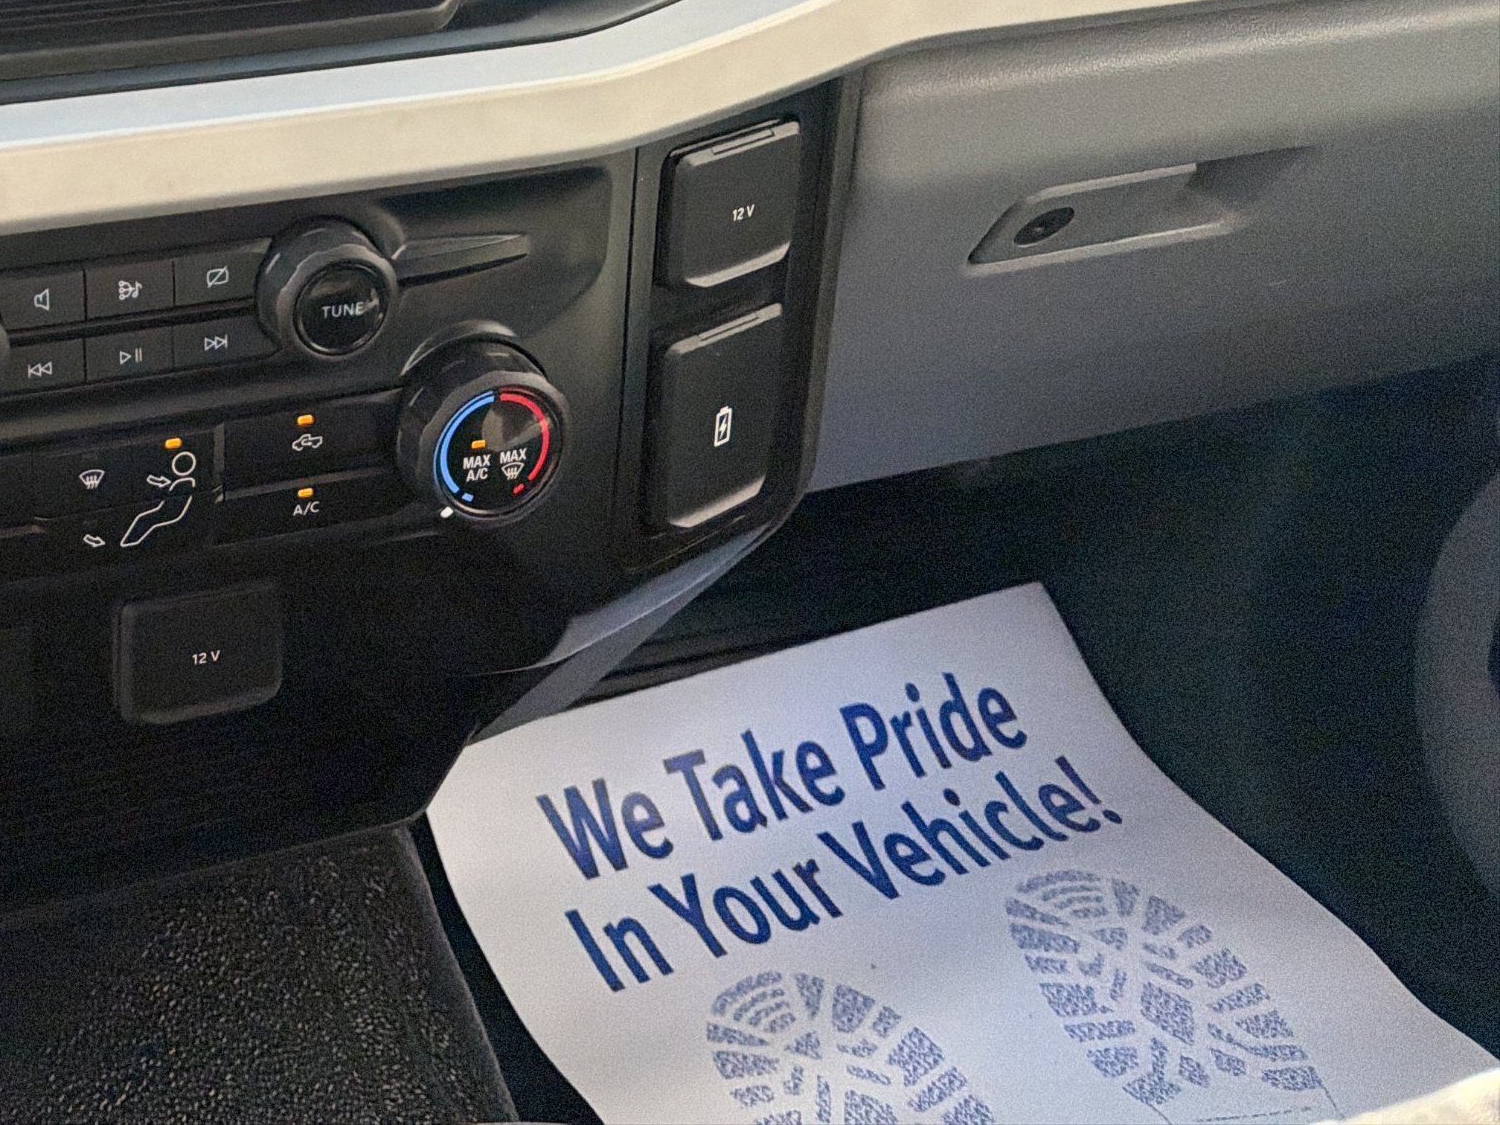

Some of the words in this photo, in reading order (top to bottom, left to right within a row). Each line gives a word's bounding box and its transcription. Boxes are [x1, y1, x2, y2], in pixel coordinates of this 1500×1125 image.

[733, 208, 746, 221] 12
[747, 203, 756, 218] V
[321, 301, 365, 319] TUNE
[463, 454, 491, 469] MAX
[500, 448, 528, 463] MAX
[466, 469, 488, 483] A/C
[293, 500, 320, 517] A/C
[192, 653, 207, 665] 12
[209, 650, 221, 663] V
[535, 778, 674, 880] We
[663, 730, 846, 841] Take
[840, 672, 1028, 791] Pride
[564, 903, 674, 993] In
[648, 857, 843, 958] Your
[816, 755, 1124, 901] Vehicle!
